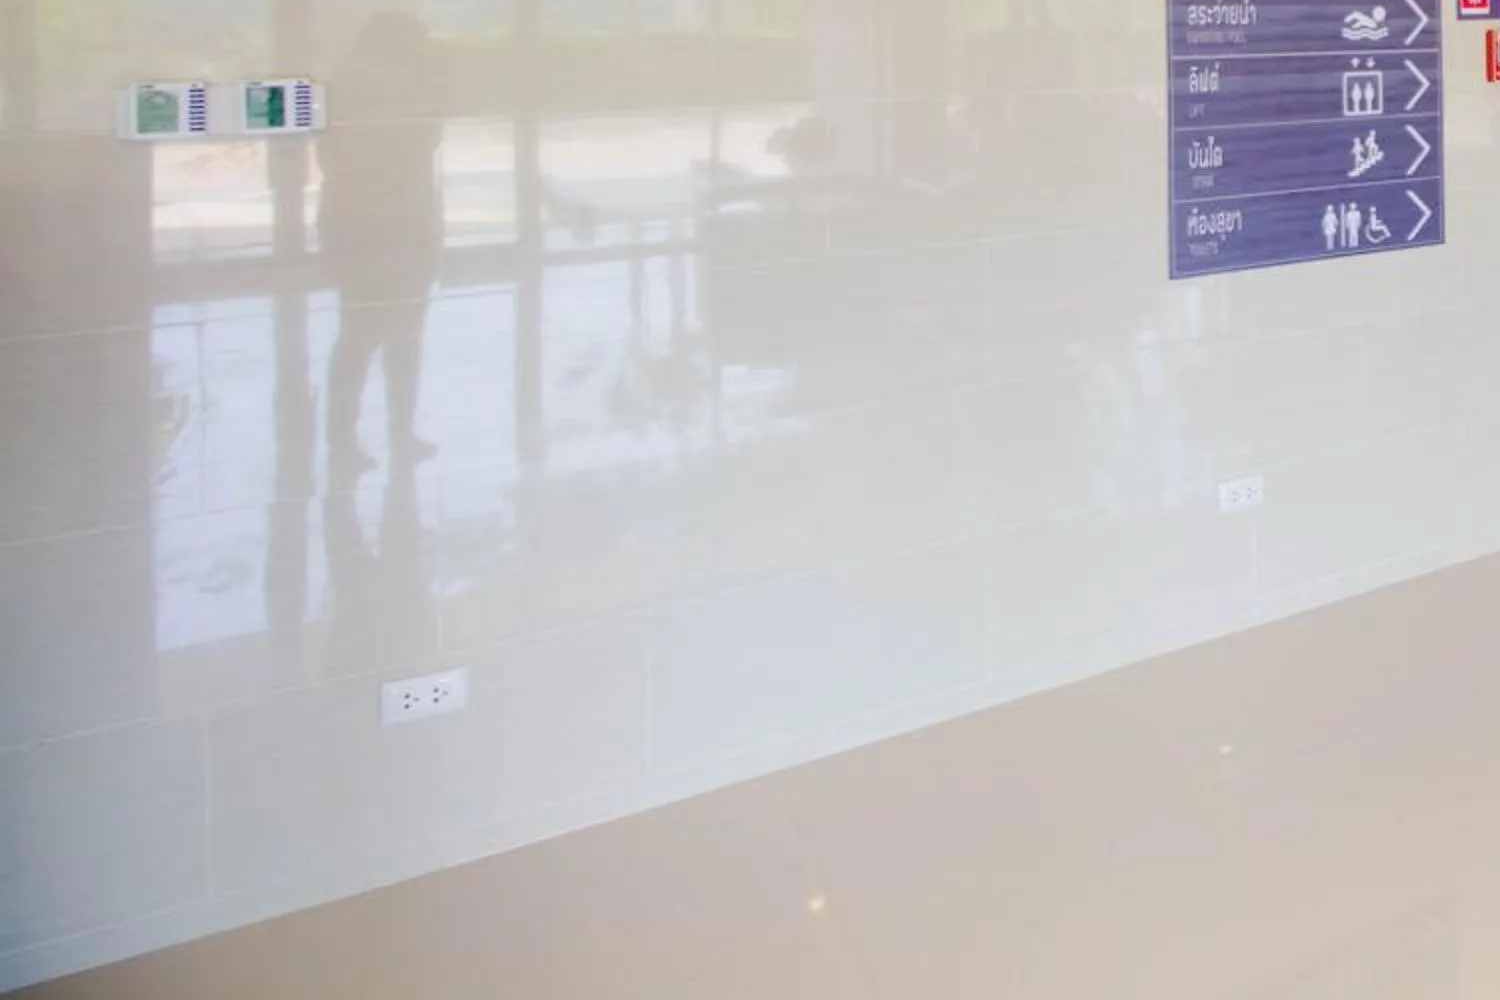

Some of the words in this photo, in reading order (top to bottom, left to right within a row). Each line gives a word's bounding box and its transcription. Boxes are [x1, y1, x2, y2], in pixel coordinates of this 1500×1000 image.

[1188, 135, 1223, 168] บันได
[1187, 206, 1243, 241] ห้องสุขา
